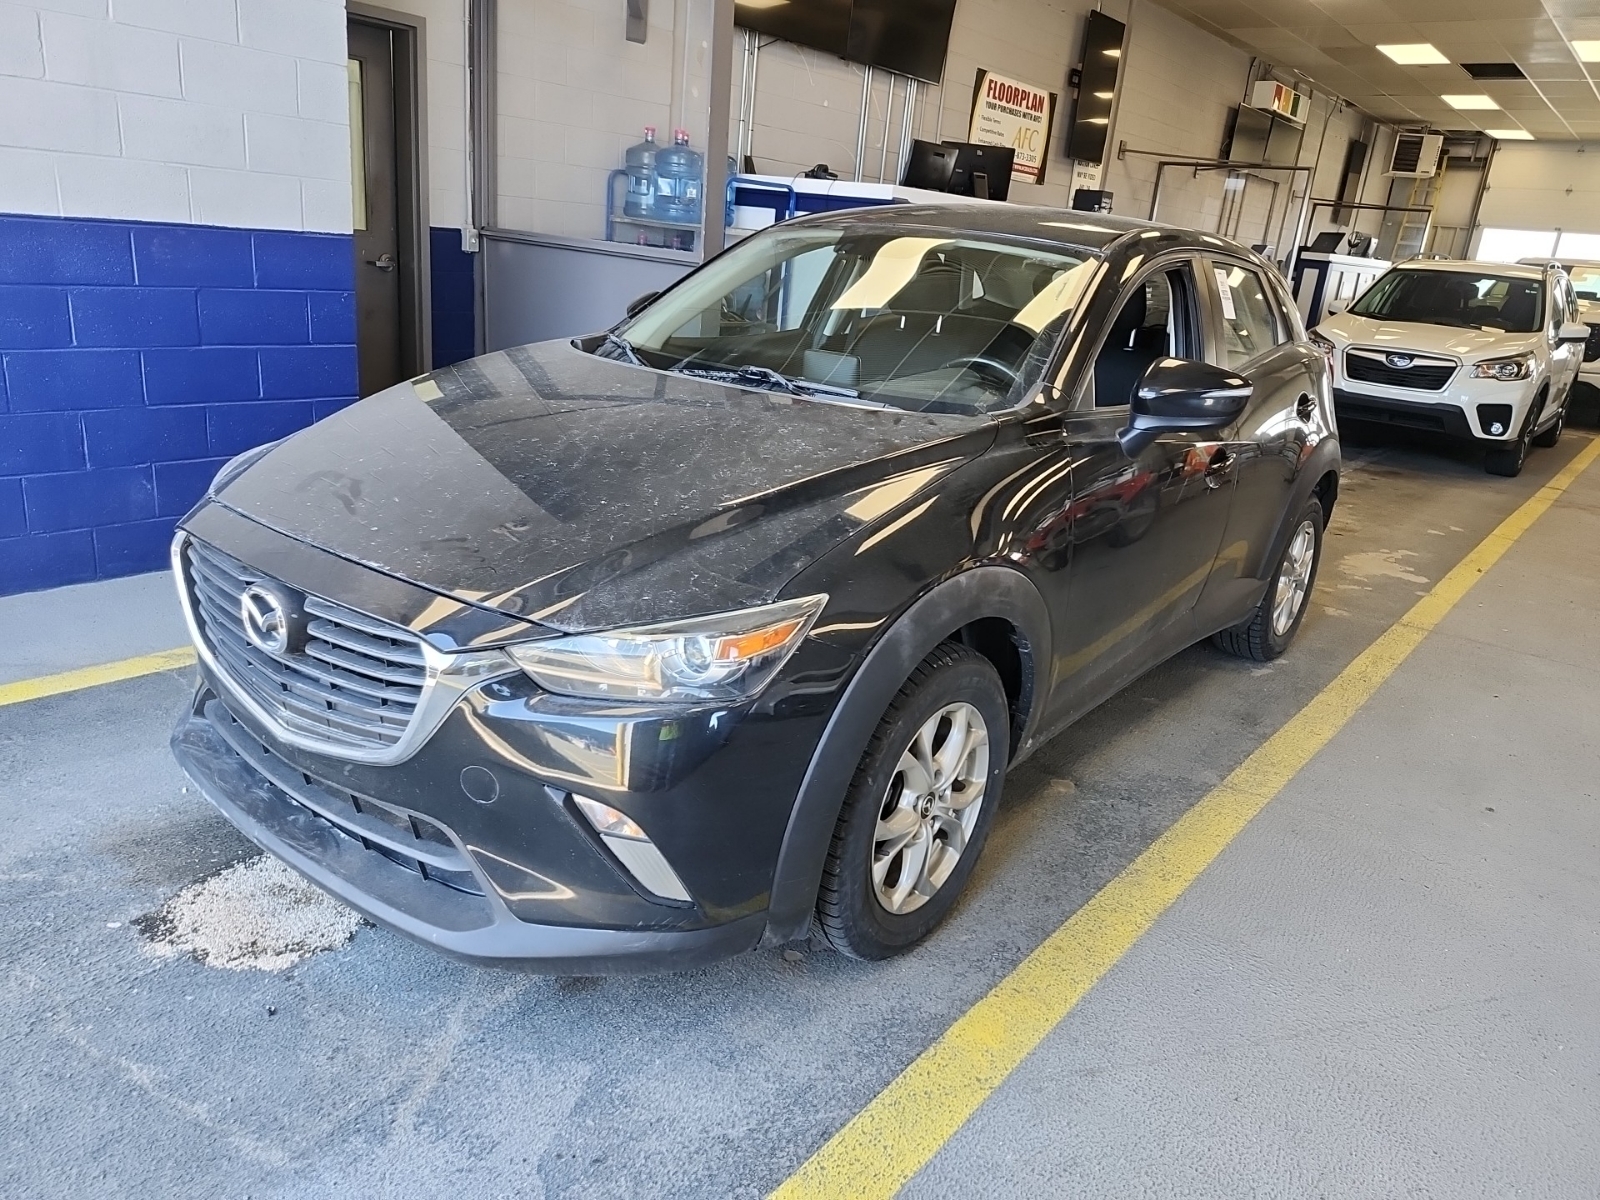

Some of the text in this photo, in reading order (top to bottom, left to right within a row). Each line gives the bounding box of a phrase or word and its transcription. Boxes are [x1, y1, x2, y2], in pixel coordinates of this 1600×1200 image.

[987, 79, 1045, 113] FLOORPLAN
[981, 114, 993, 122] Flexible
[986, 101, 997, 111] YOUR
[997, 104, 1022, 118] PURCHASES
[1021, 111, 1033, 121] WITH
[979, 126, 998, 135] Competitive
[1011, 126, 1040, 152] AFC
